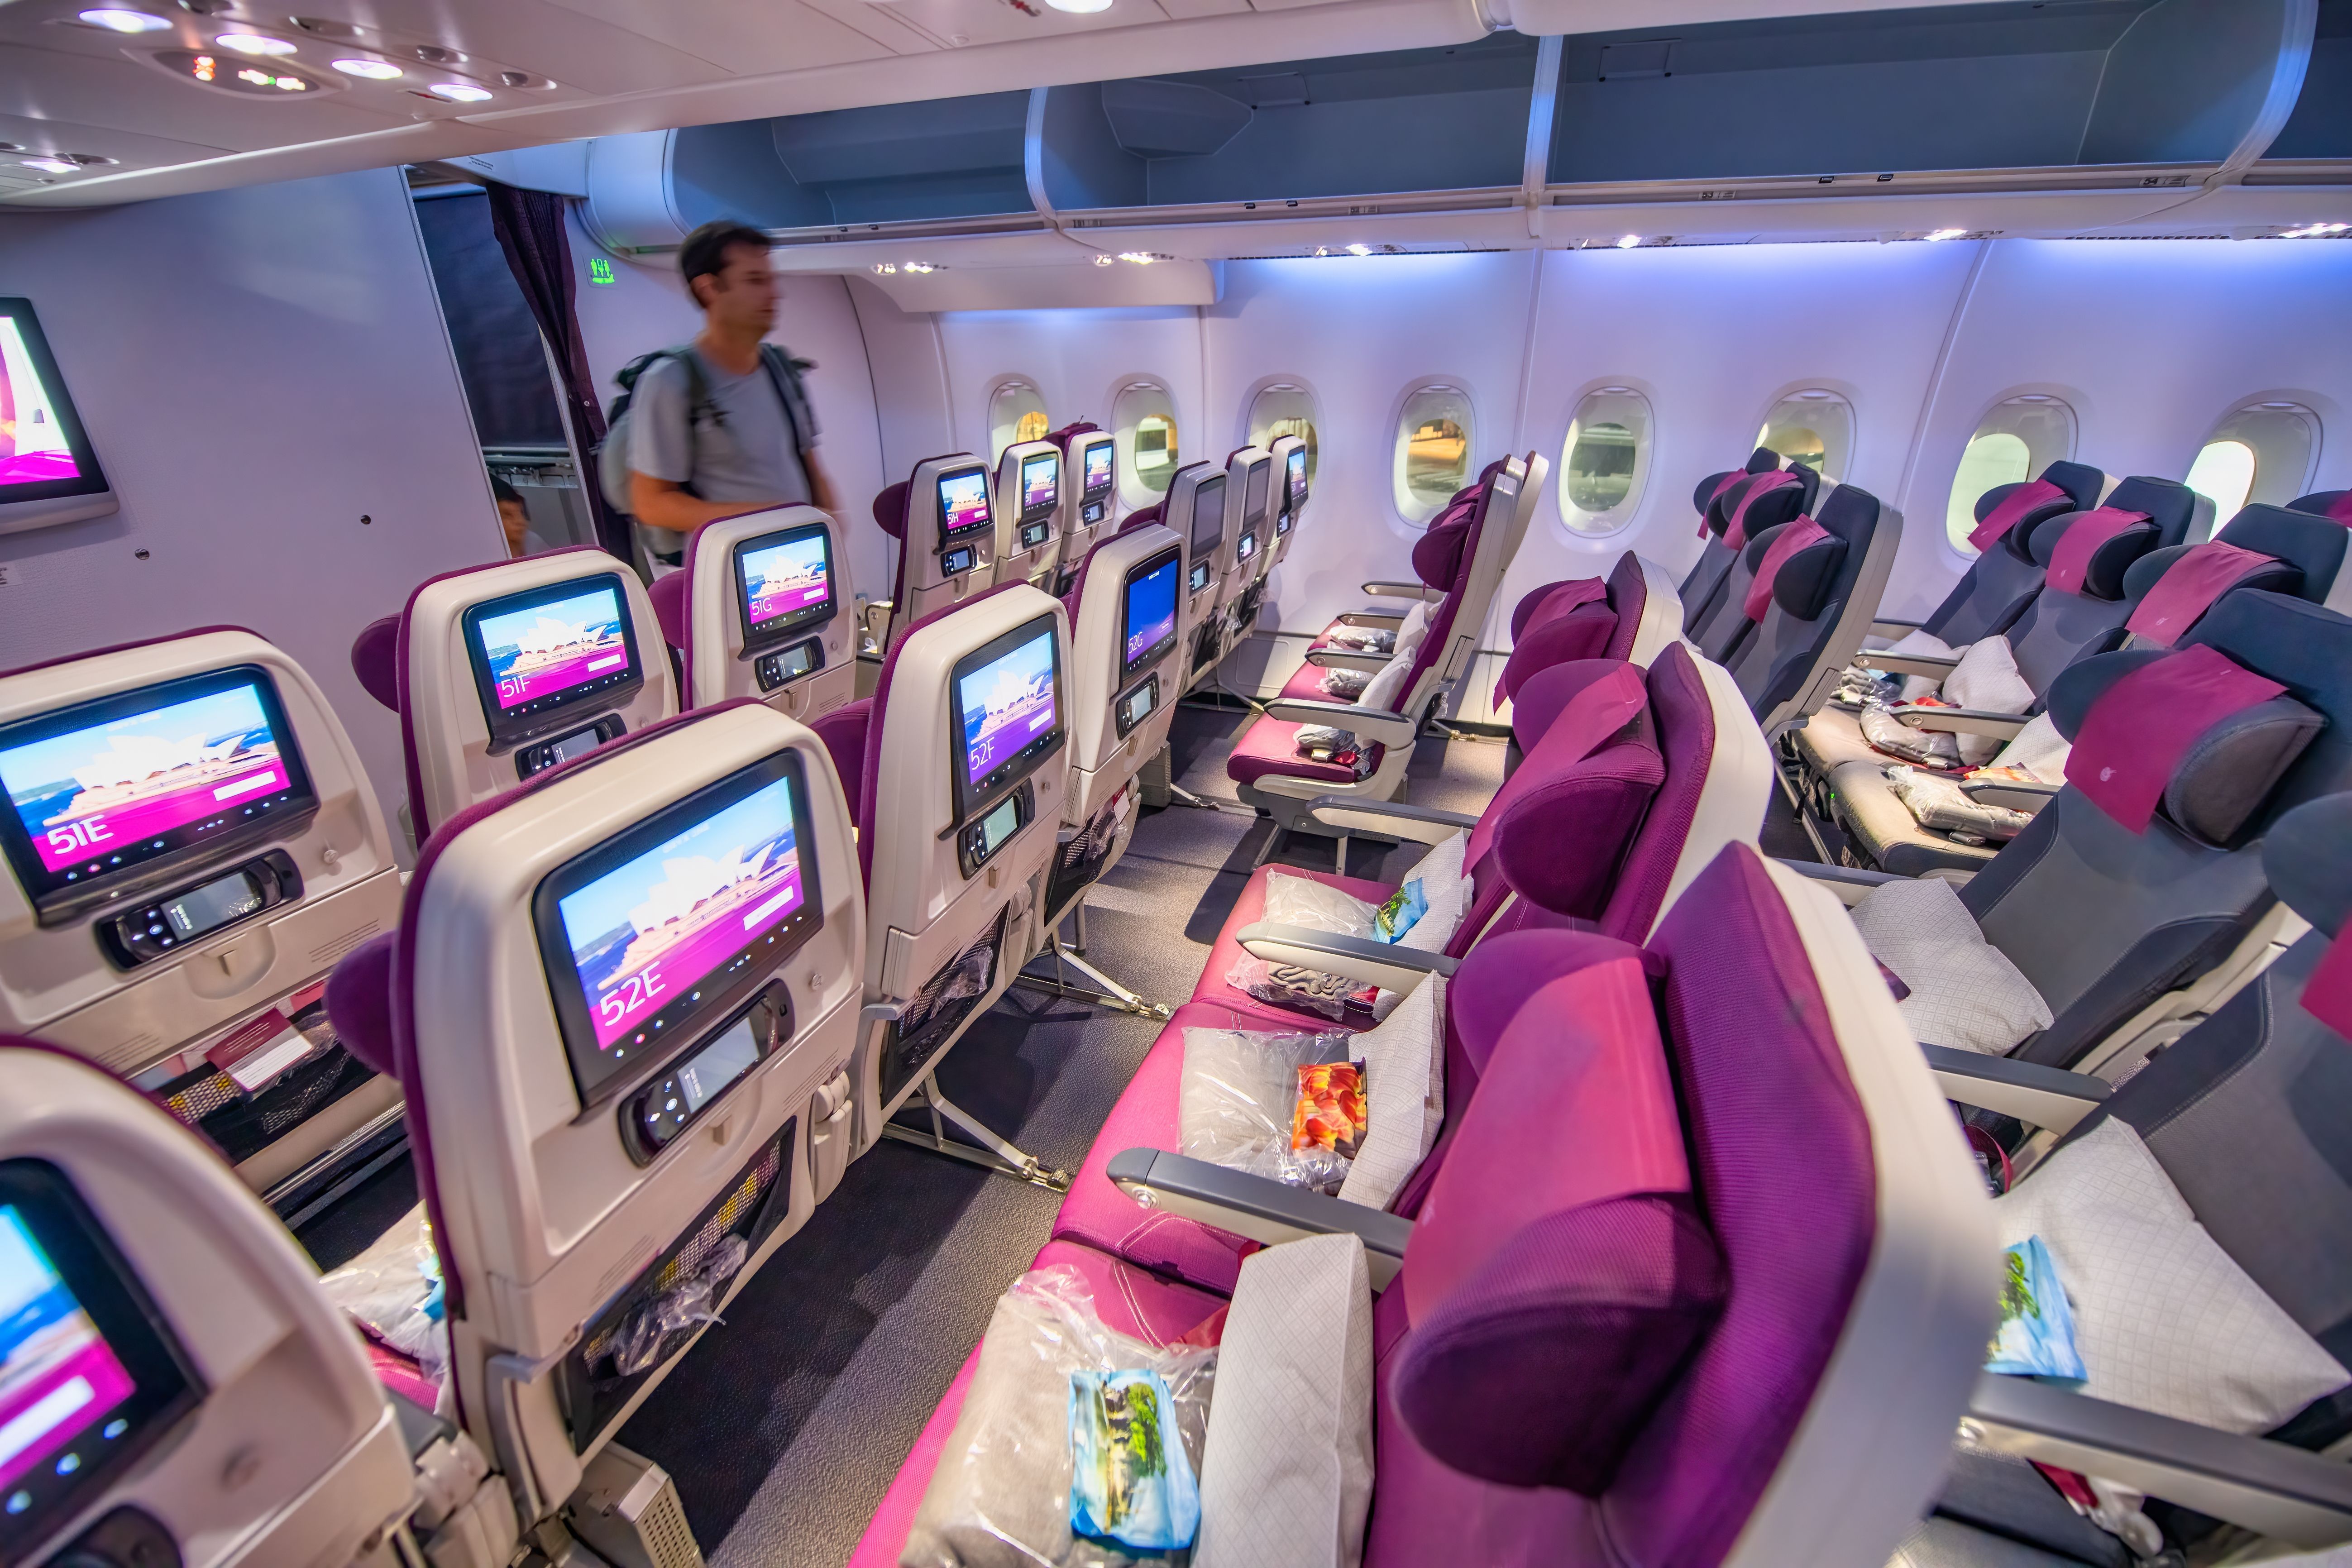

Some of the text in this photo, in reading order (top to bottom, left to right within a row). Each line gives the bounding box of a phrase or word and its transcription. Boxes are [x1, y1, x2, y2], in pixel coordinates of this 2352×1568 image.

[947, 512, 959, 525] 51H
[752, 598, 772, 616] 51G
[1128, 631, 1143, 654] 52G
[501, 673, 530, 698] 51F
[970, 736, 994, 770] 52F
[47, 814, 114, 854] 51E
[600, 961, 666, 1027] 52E
